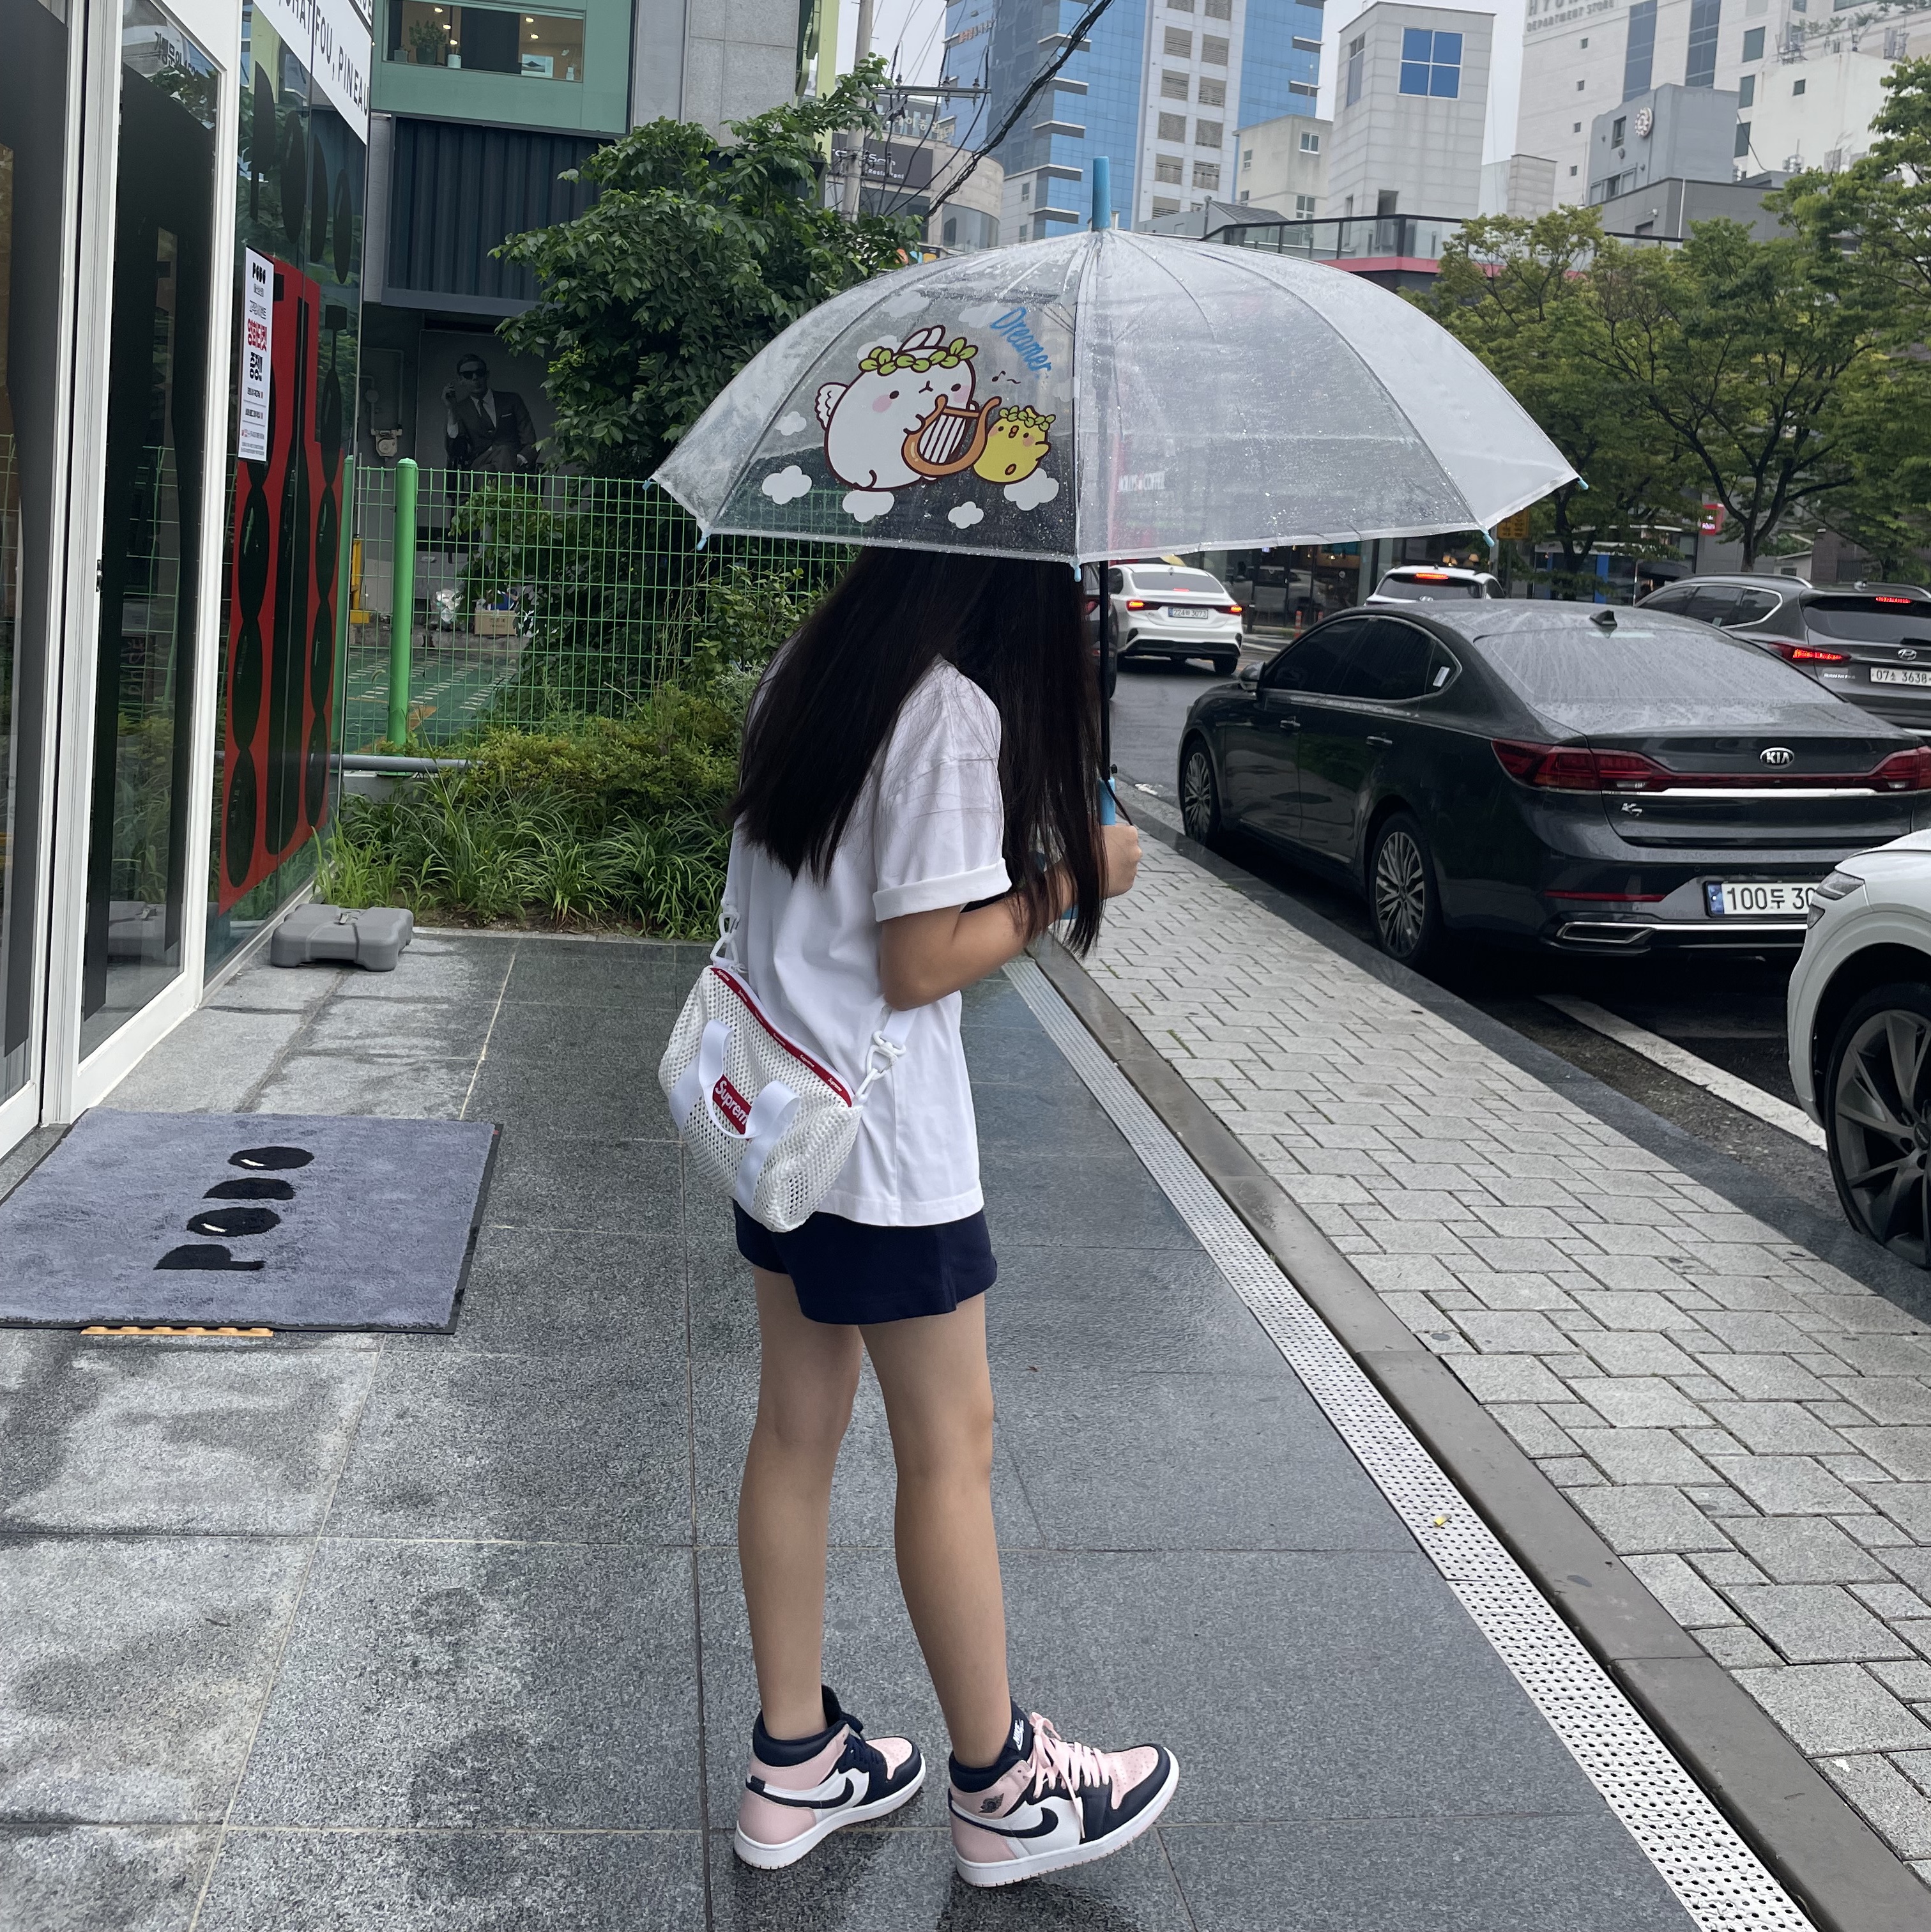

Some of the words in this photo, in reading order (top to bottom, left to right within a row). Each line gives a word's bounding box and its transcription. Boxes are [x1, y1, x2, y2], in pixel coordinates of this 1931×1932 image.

[1526, 6, 1585, 33] DEPARTMENT
[338, 45, 369, 116] PINEAU
[868, 168, 904, 180] Restarant
[990, 307, 1051, 372] Dreamer
[1902, 671, 1927, 684] 3638
[1766, 751, 1790, 764] KIA
[1727, 887, 1785, 910] 100두
[715, 1080, 749, 1126] Suprem
